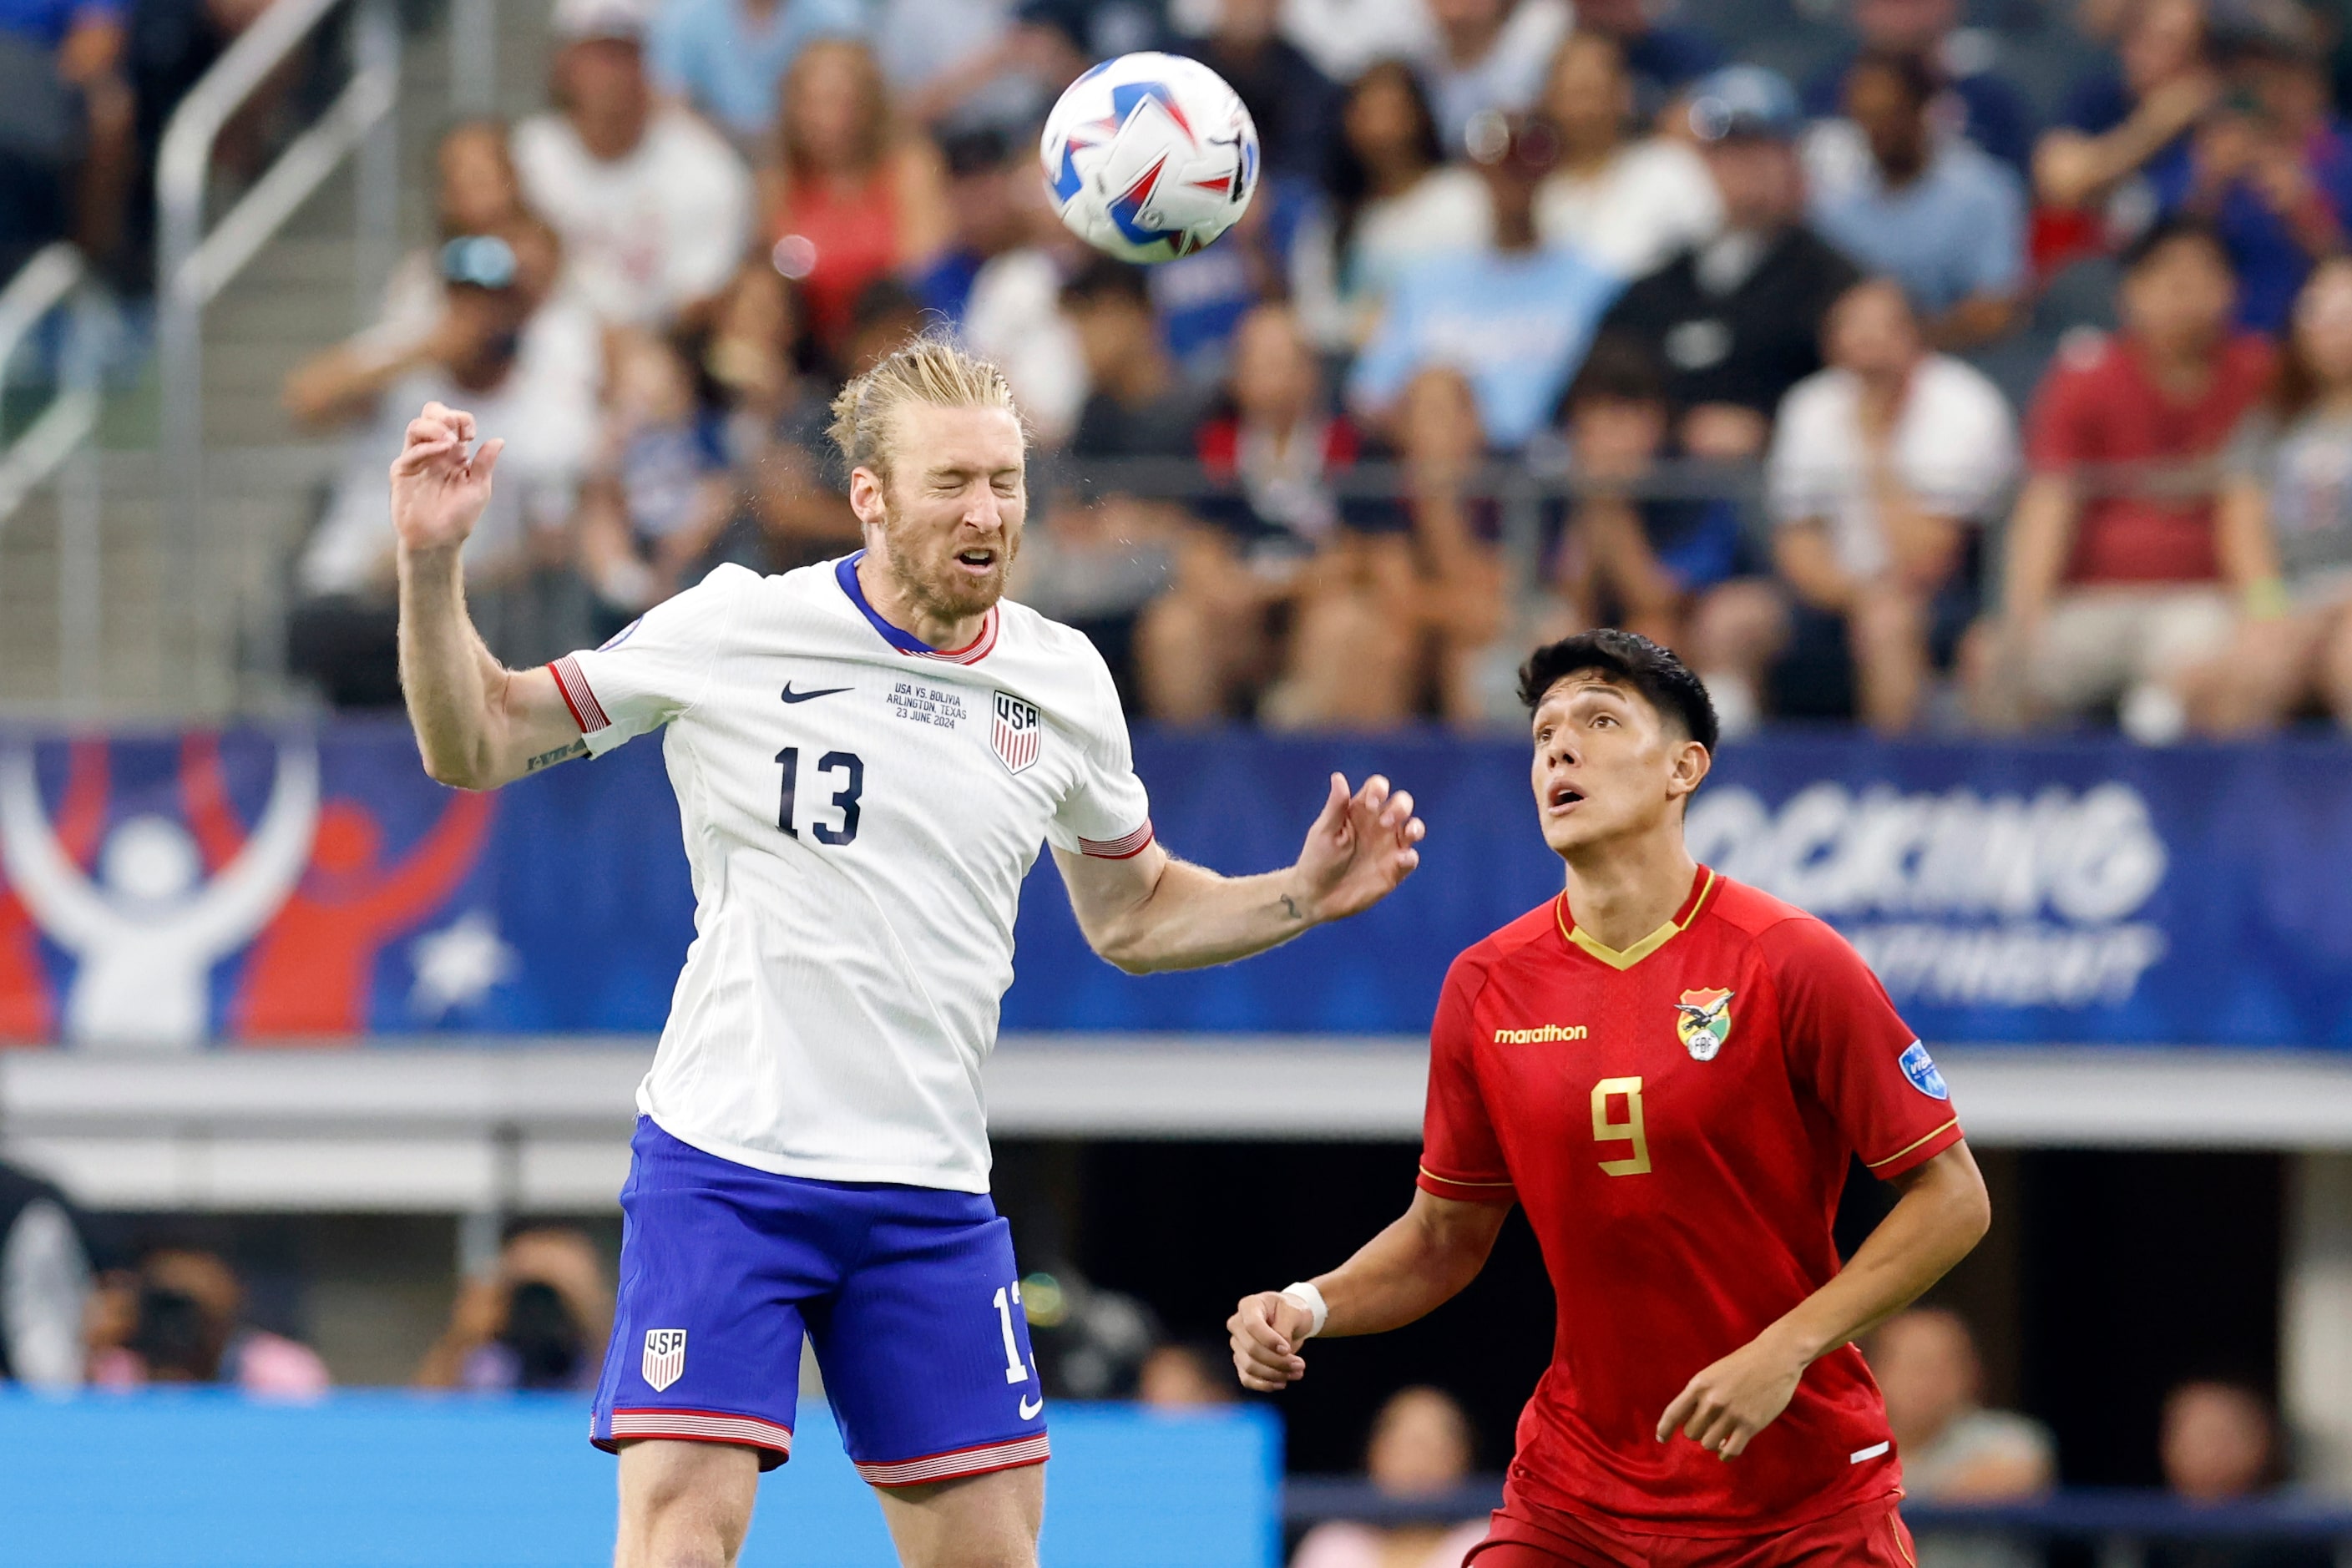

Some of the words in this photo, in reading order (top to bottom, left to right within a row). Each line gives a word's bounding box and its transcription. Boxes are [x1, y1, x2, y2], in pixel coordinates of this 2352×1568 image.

[886, 693, 937, 714] ARLINGTON,
[940, 704, 967, 720] TEXAS
[895, 682, 912, 695] USA
[915, 686, 928, 699] VS.
[929, 690, 960, 706] BOLIVIA
[896, 707, 908, 718] 23
[910, 711, 932, 724] JUNE
[933, 715, 954, 729] 2024
[997, 696, 1036, 731] USA
[774, 746, 864, 846] 13
[1683, 781, 2171, 923] OCKING
[1494, 1024, 1588, 1044] marathon
[1591, 1075, 1651, 1176] 9
[647, 1333, 683, 1355] USA
